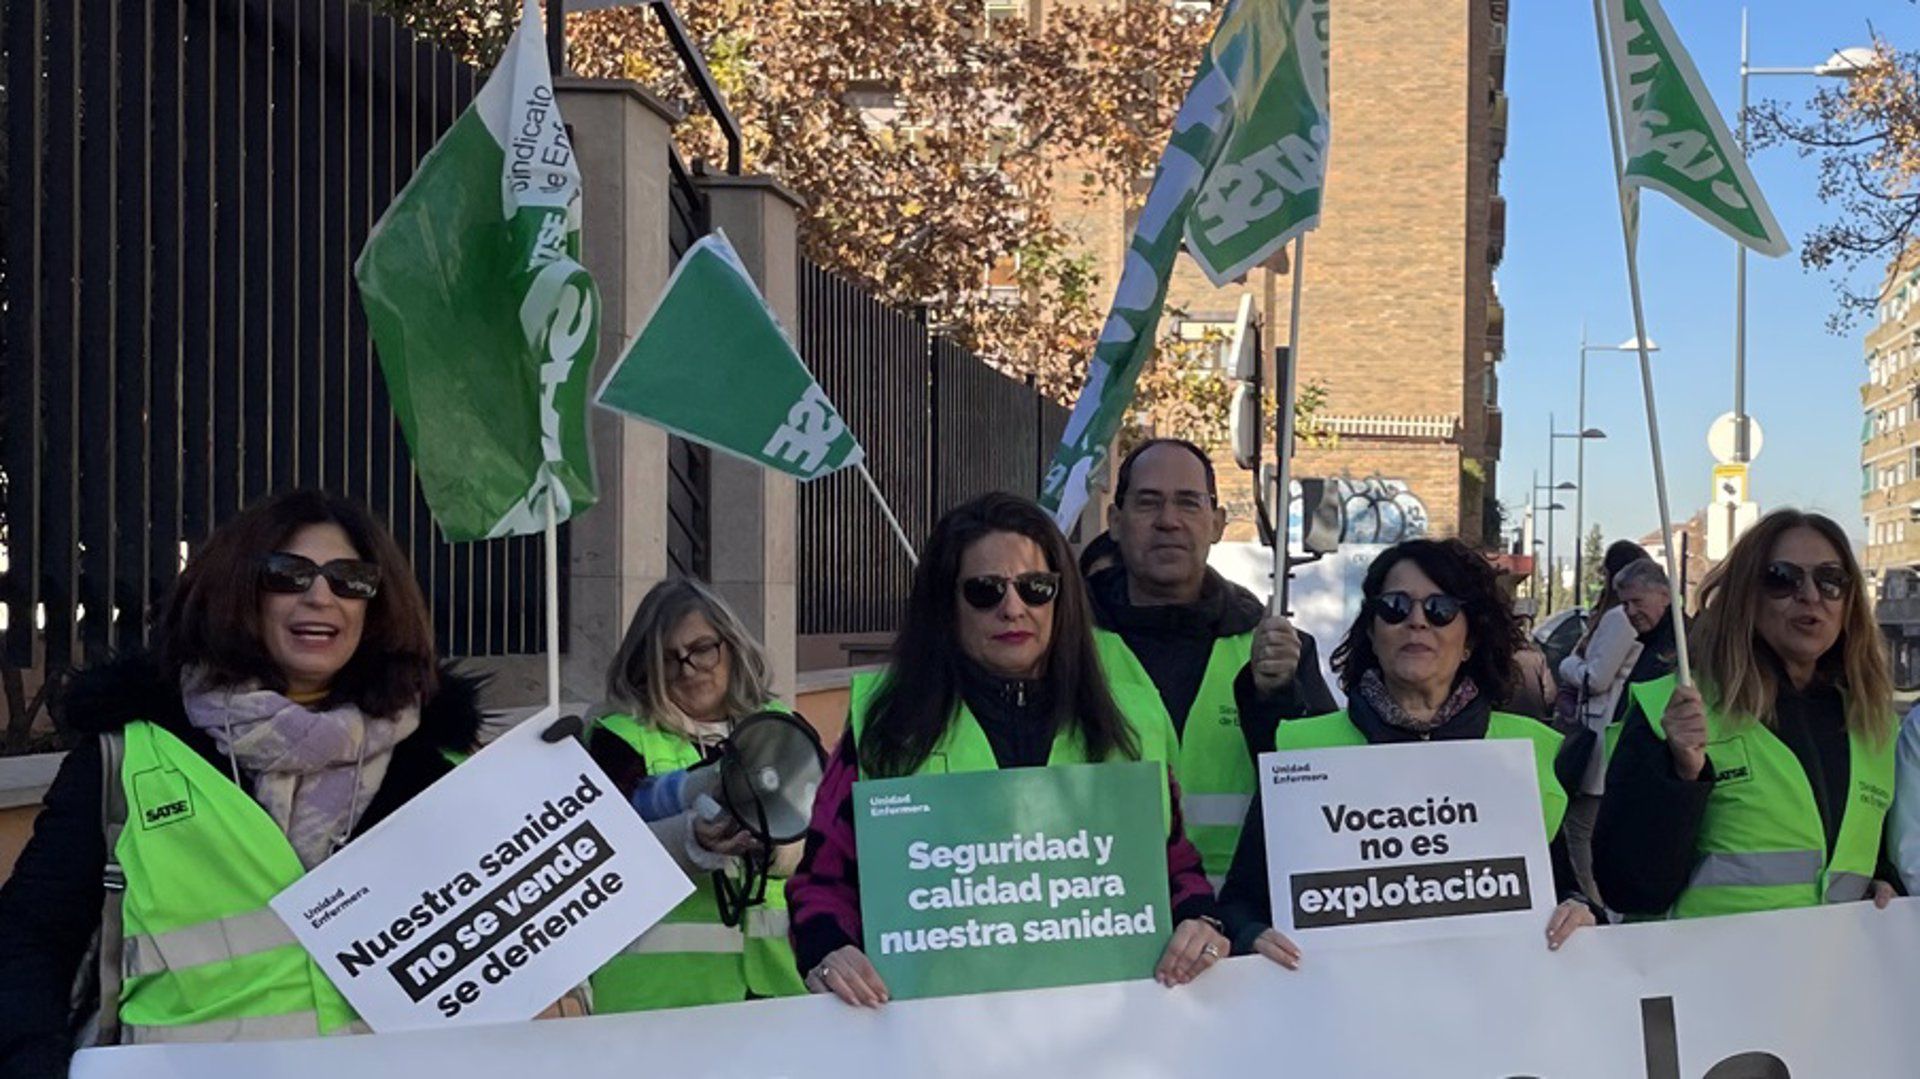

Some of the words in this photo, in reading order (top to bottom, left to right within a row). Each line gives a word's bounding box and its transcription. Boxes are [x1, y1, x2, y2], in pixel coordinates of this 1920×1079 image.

[1272, 763, 1311, 774] Unidad
[1273, 772, 1328, 784] Enfermera
[146, 800, 189, 822] SATSE
[869, 794, 912, 806] Unidad
[870, 804, 930, 816] Enfermera
[1322, 797, 1478, 833] Vocación
[908, 830, 1089, 874] Seguridad
[1094, 835, 1113, 865] y
[1360, 837, 1402, 860] no
[1411, 833, 1449, 855] es
[334, 867, 481, 978] Nuestra
[478, 773, 604, 878] sanidad
[908, 872, 1042, 910] calidad
[1050, 873, 1125, 908] para
[1299, 868, 1520, 918] explotación
[303, 887, 345, 920] Unidad
[311, 886, 370, 929] Enfermera
[405, 942, 458, 987] no
[455, 909, 500, 952] se
[496, 835, 599, 917] vende
[437, 980, 480, 1018] se
[482, 870, 624, 984] defiende
[880, 919, 1017, 955] nuestra
[1023, 905, 1155, 942] sanidad
